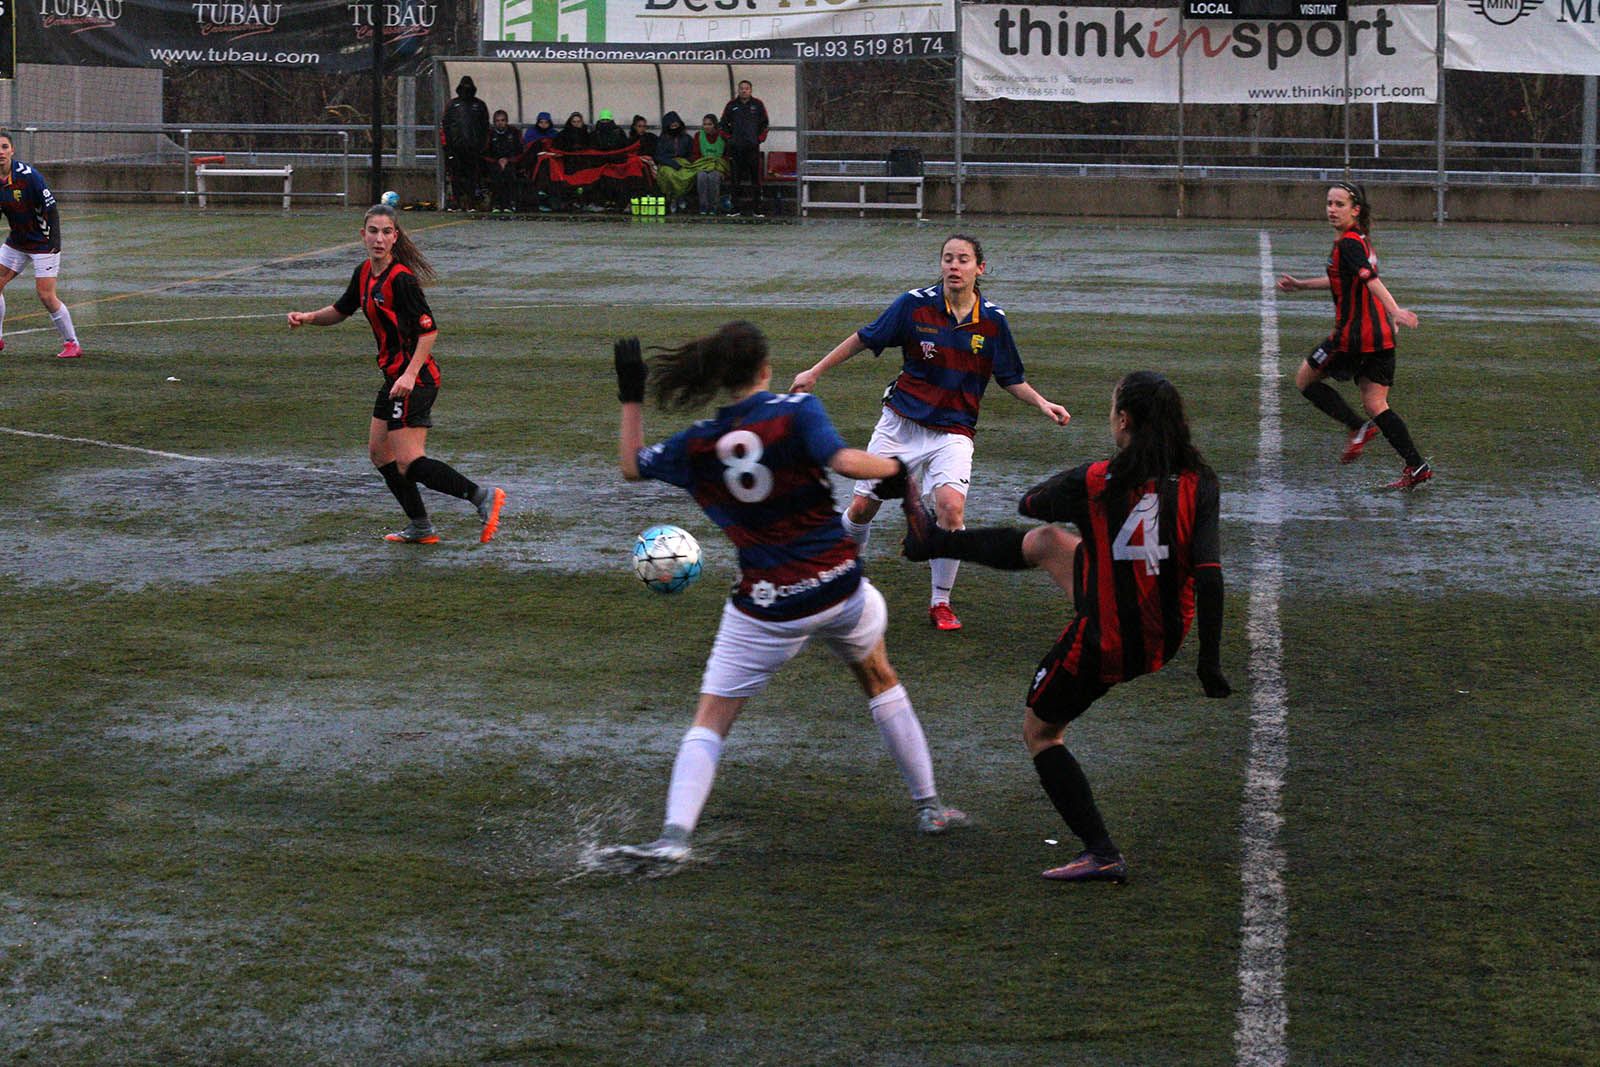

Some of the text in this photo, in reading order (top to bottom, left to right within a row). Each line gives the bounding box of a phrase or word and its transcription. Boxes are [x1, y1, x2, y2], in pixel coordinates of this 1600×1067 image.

[39, 0, 122, 20] TUBAU
[192, 3, 282, 26] TUBAU
[1190, 3, 1232, 14] LOCAL
[1300, 4, 1337, 15] VISITANT
[1486, 0, 1518, 10] MINI
[1556, 0, 1600, 23] M
[639, 18, 785, 41] VAPOR
[994, 8, 1396, 70] thinkinsport
[150, 48, 320, 63] www.tubau.com
[853, 39, 887, 56] 519
[892, 38, 913, 54] 81
[921, 37, 943, 54] 74
[1248, 84, 1425, 101] www.thinkinsport.com
[392, 401, 403, 419] 5
[716, 430, 774, 503] 8
[1112, 493, 1169, 576] 4
